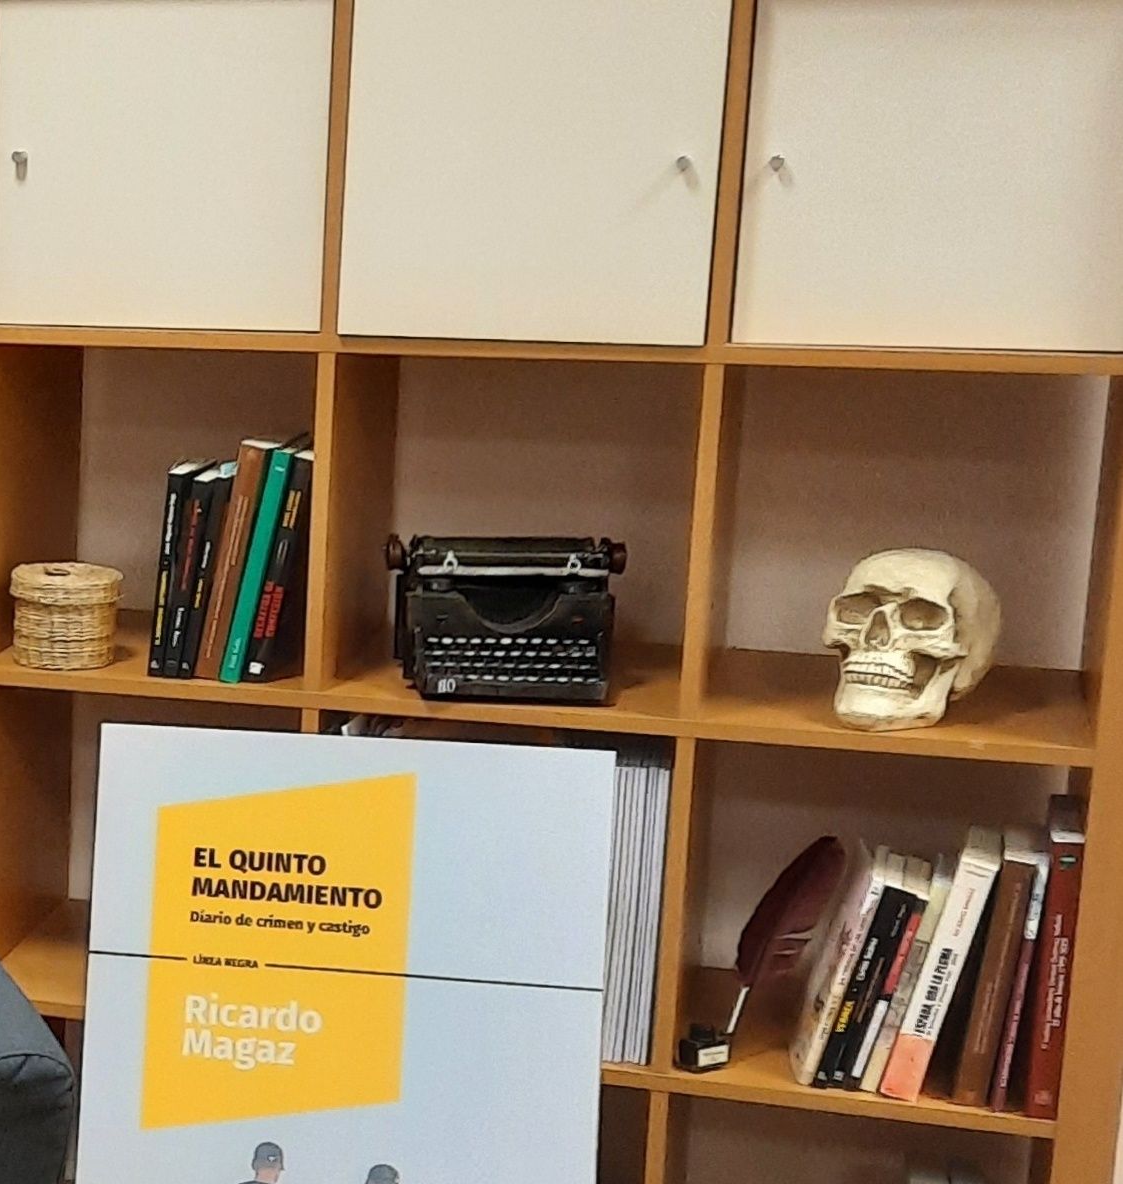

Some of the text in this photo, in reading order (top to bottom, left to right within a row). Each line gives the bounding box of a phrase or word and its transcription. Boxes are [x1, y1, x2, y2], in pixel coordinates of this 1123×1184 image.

[193, 847, 326, 876] EL QUINTO
[191, 877, 383, 909] MANDAMIENTO
[190, 909, 371, 938] Diario de crimen y castigo
[224, 957, 259, 969] NEGRA
[184, 992, 323, 1034] Ricardo
[182, 1027, 297, 1070] Magaz
